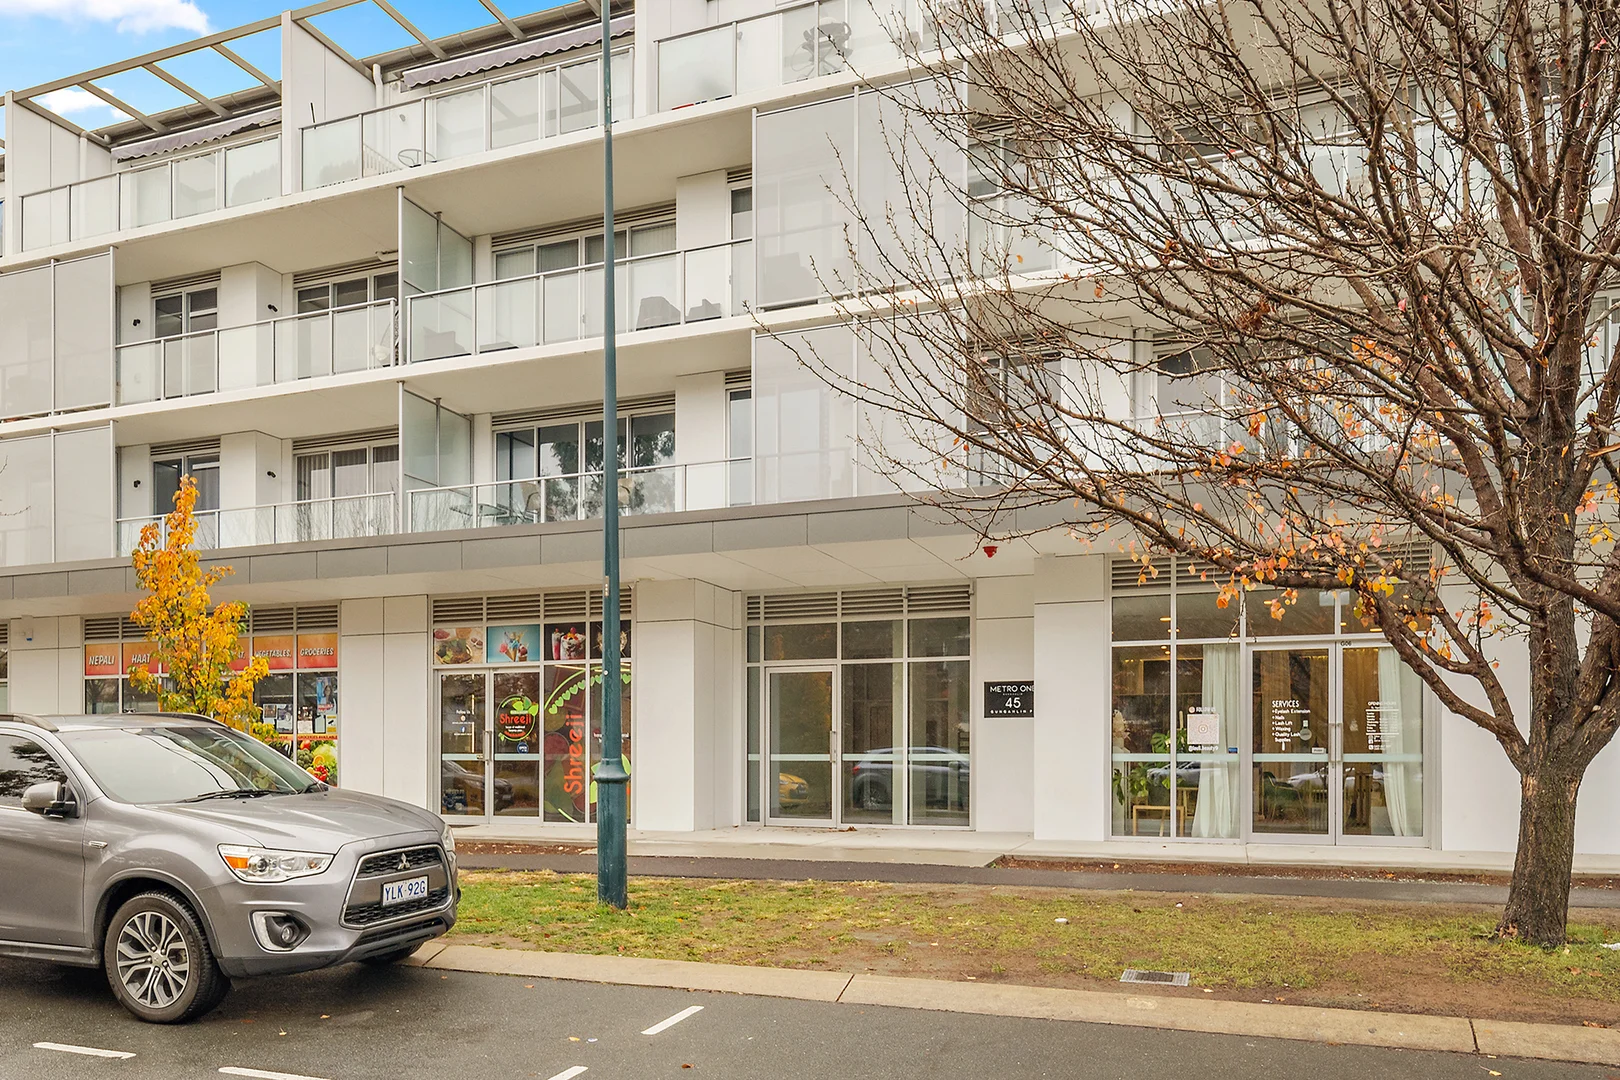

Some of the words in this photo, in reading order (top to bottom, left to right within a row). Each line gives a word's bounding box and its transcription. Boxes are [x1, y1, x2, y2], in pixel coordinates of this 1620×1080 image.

[299, 647, 334, 656] GROCERIES
[88, 655, 115, 666] NEPALI
[131, 653, 151, 664] HAAT
[990, 685, 1018, 693] METRO
[1005, 697, 1021, 709] 45
[1272, 700, 1300, 708] SERVICES
[564, 714, 584, 795] Shreeji
